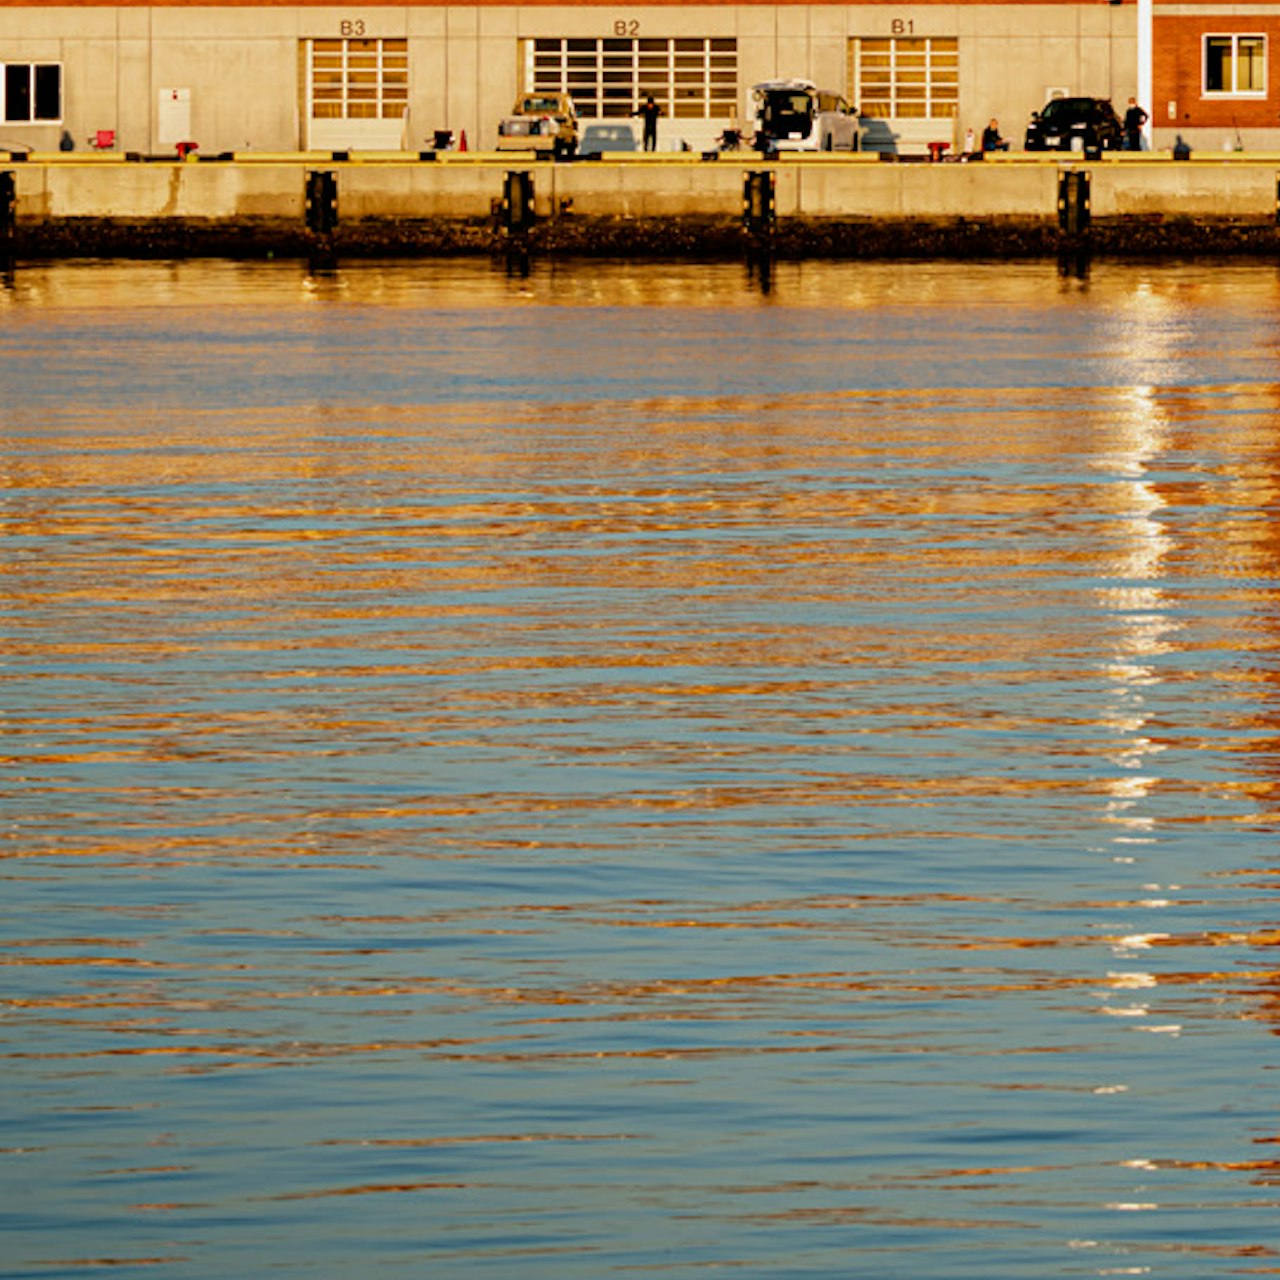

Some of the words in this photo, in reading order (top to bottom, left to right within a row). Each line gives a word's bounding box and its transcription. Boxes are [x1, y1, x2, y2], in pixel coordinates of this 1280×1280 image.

[341, 20, 365, 36] B3
[614, 20, 639, 36] B2
[891, 18, 914, 34] B1
